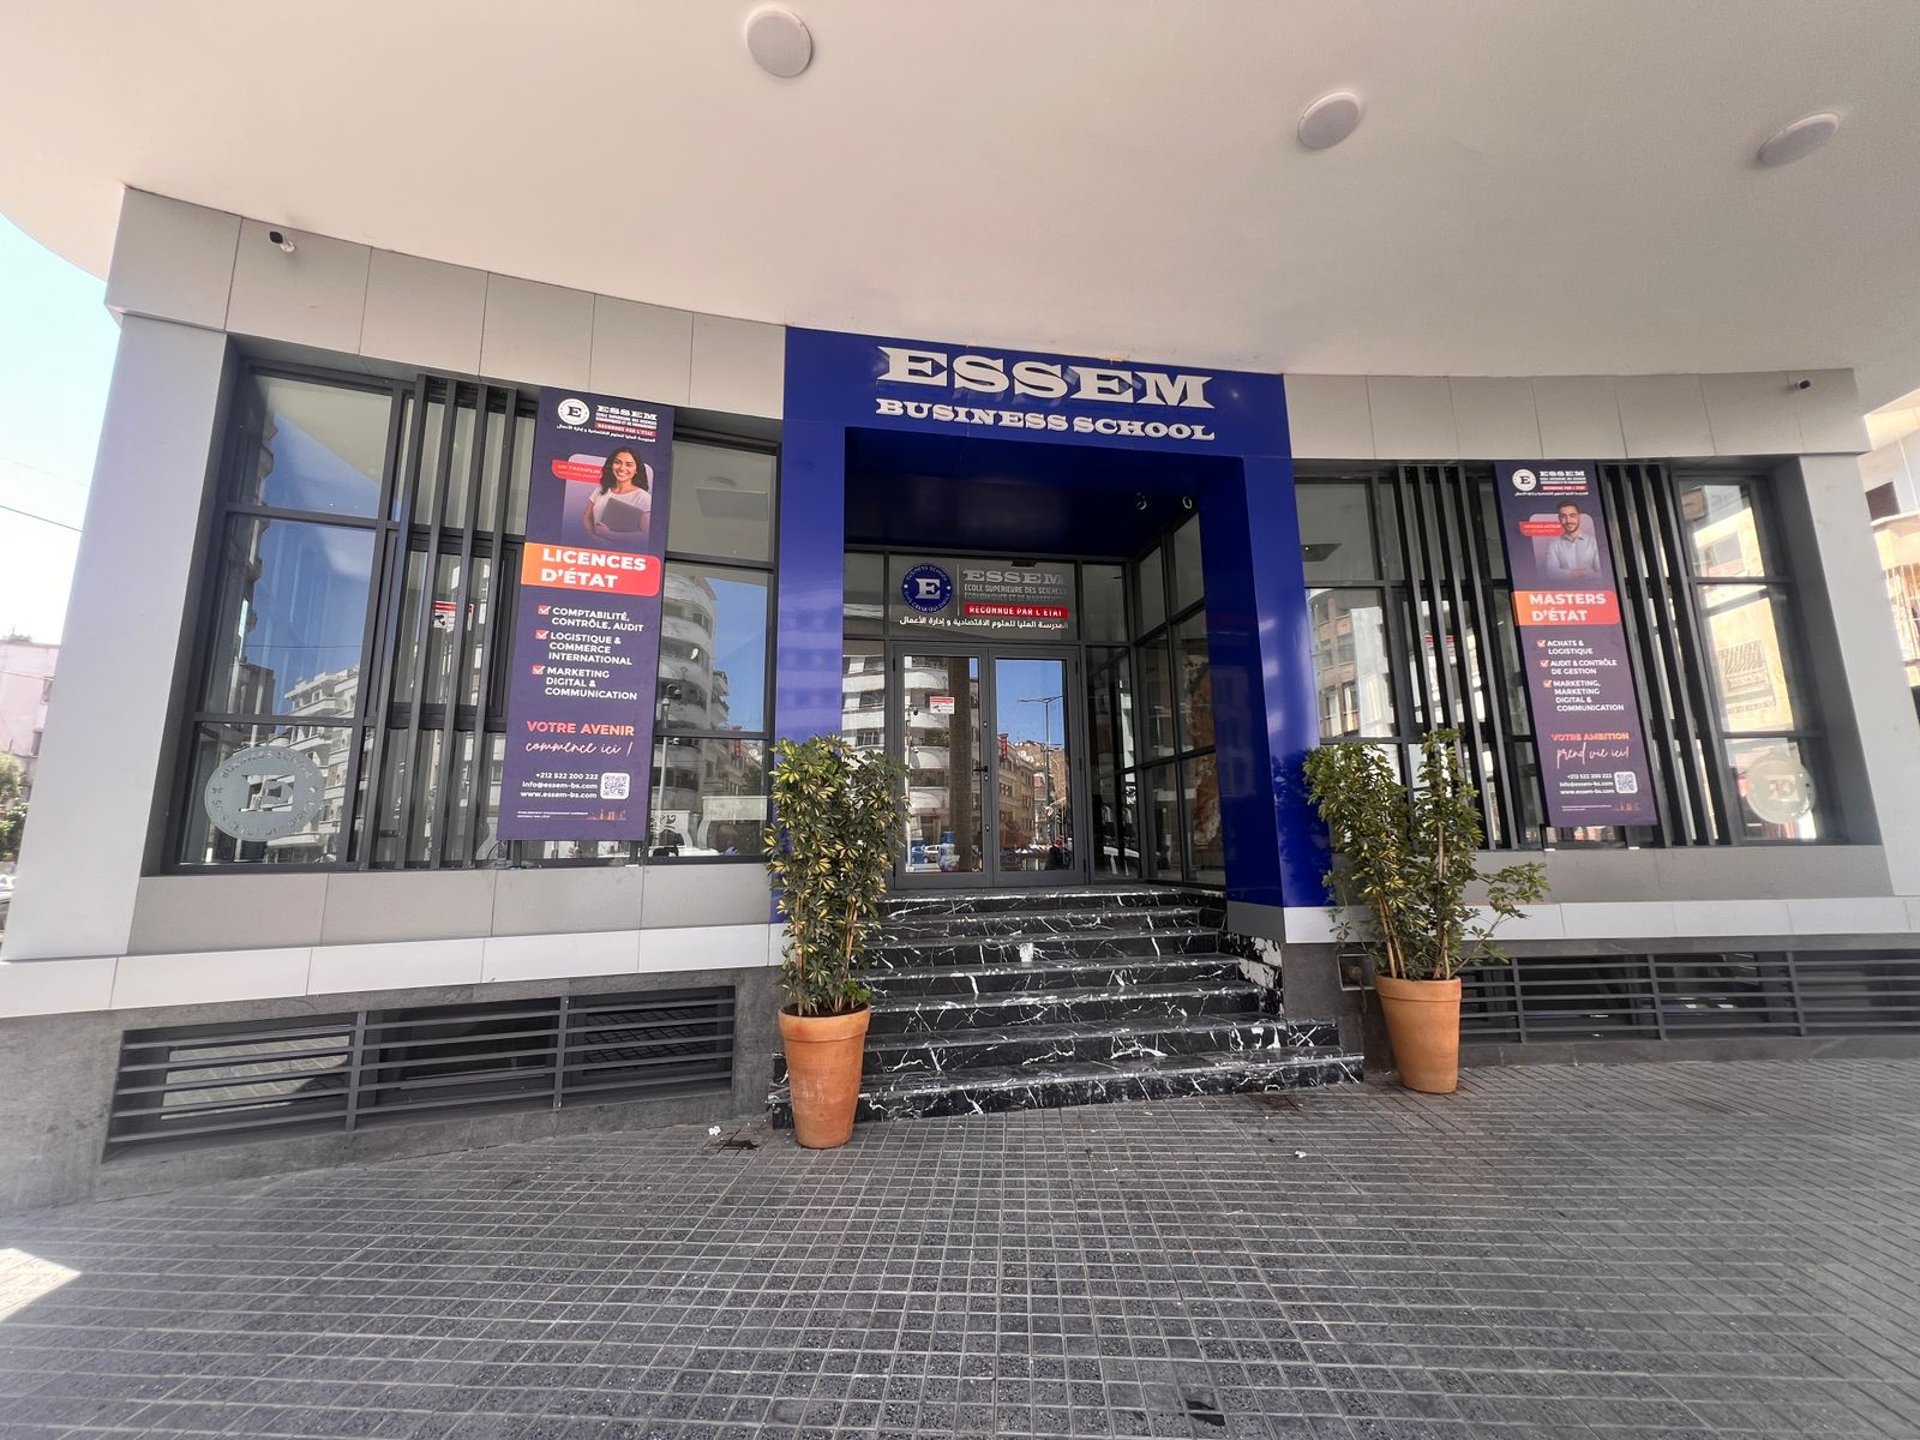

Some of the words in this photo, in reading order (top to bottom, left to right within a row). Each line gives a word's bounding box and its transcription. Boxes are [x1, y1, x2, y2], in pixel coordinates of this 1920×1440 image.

[877, 346, 1216, 409] ESSEM
[567, 406, 582, 418] E
[596, 405, 658, 420] ESSEM
[875, 398, 1069, 431] BUSINESS
[1073, 417, 1216, 441] SCHOOL
[1520, 475, 1531, 485] E
[543, 548, 647, 572] LICENCES
[541, 567, 618, 589] D'ÉTAT
[962, 569, 1064, 585] ESSEM
[915, 578, 941, 599] E
[964, 583, 983, 592] ECOLE
[1024, 586, 1037, 594] DES
[1528, 593, 1606, 605] MASTERS
[552, 607, 630, 622] COMPTABILITÉ,
[969, 605, 1014, 615] RECONNUE
[1016, 607, 1033, 616] PAR
[1531, 607, 1588, 622] D'ÉTAT
[551, 617, 612, 631] CONTRÔLE,
[612, 622, 644, 632] AUDIT
[550, 632, 612, 645] LOGISTIQUE
[613, 637, 622, 645] &
[549, 642, 612, 654] COMMERCE
[548, 652, 633, 666] INTERNATIONAL
[1578, 658, 1617, 667] CONTRÔLE
[546, 666, 610, 679] MARKETING
[545, 677, 587, 687] DIGITAL
[588, 680, 596, 688] &
[544, 687, 638, 701] COMMUNICATION
[1556, 704, 1625, 712] COMMUNICATION
[526, 720, 577, 734] VOTRE
[580, 723, 635, 736] AVENIR
[1551, 732, 1582, 741] VOTRE
[1583, 732, 1630, 741] AMBITION
[525, 741, 597, 754] commence
[600, 743, 622, 755] ici
[1556, 741, 1587, 769] prend
[1589, 748, 1608, 759] vie
[553, 772, 568, 780] 522
[520, 791, 598, 799] www.essem-bs.com
